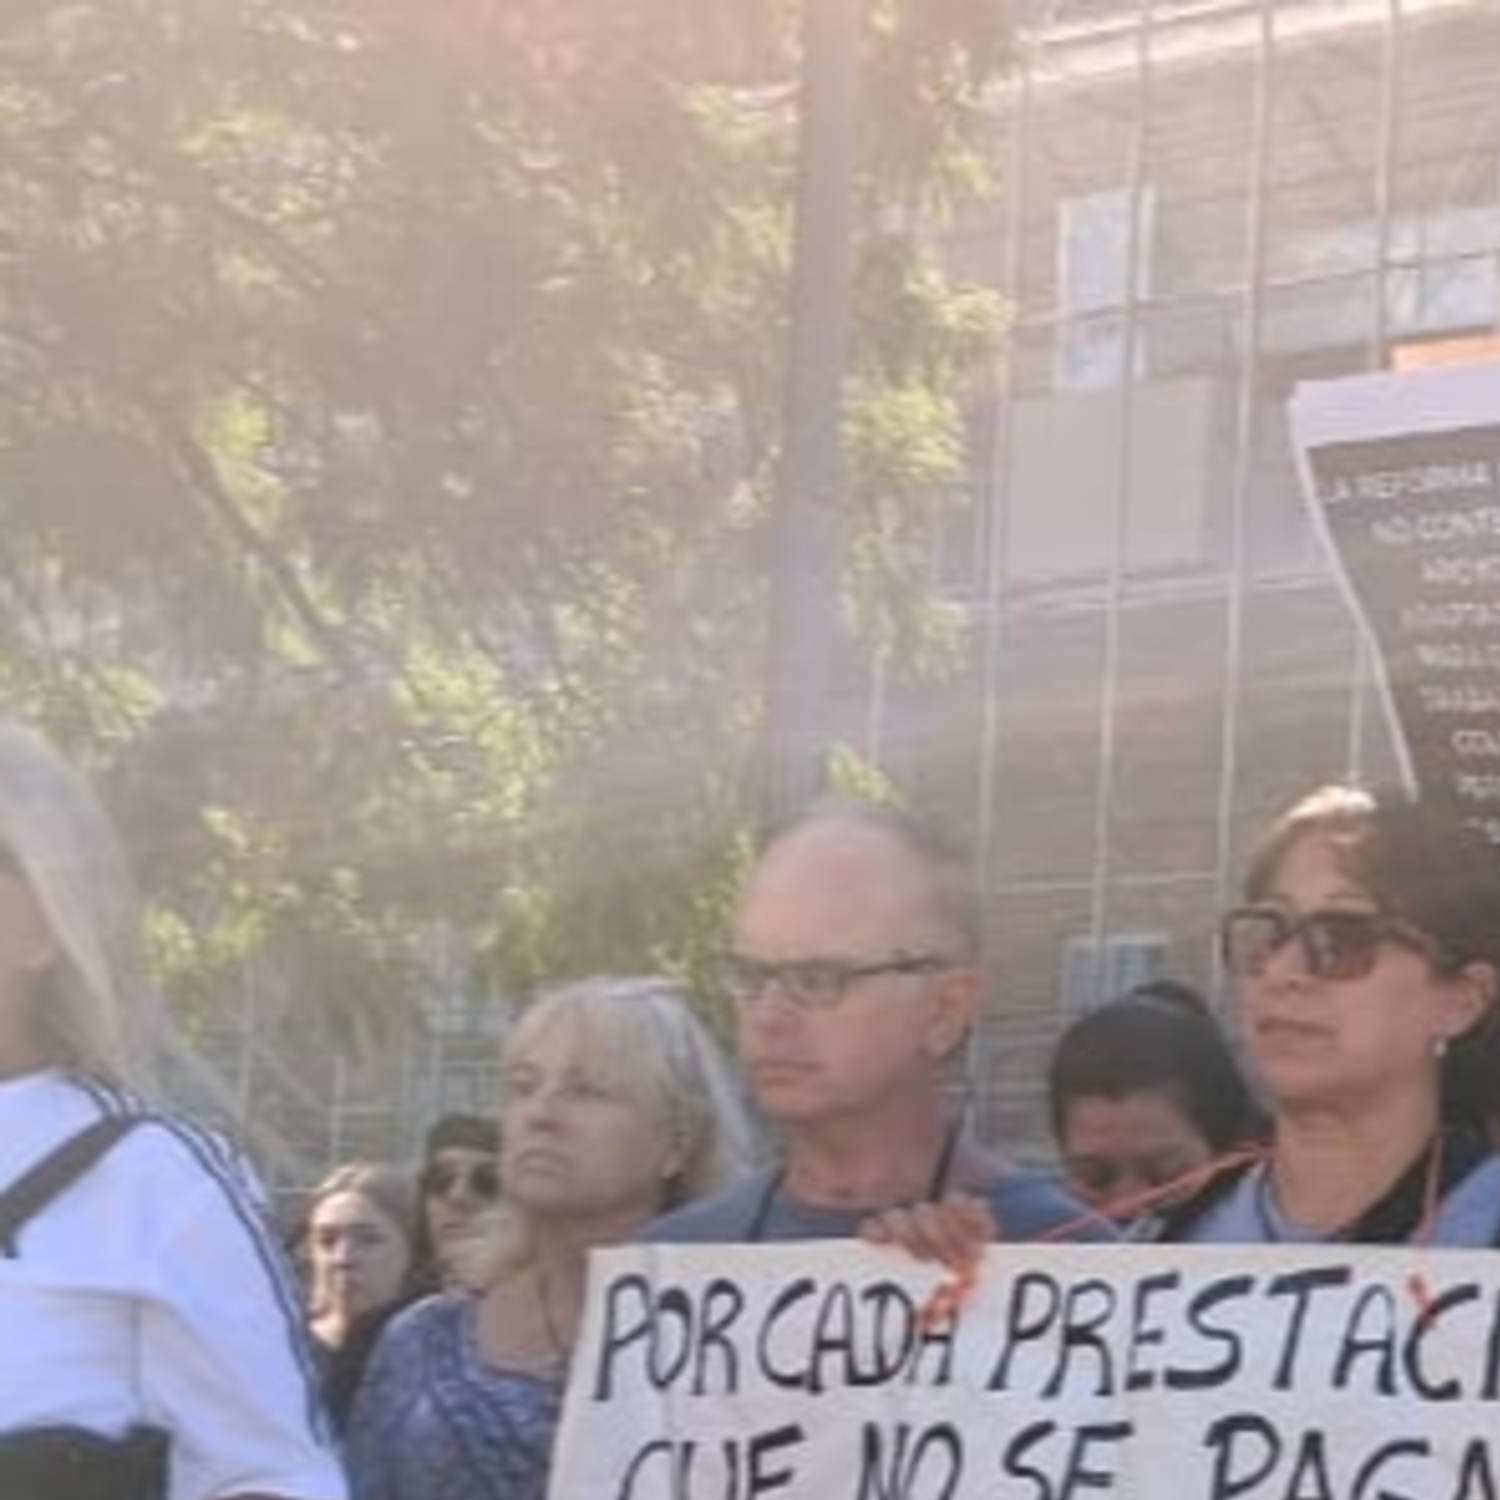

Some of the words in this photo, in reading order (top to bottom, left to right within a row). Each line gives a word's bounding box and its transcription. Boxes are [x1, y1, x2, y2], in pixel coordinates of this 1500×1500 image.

[1357, 462, 1490, 500] REFORMA
[594, 1274, 744, 1401] POR
[757, 1277, 960, 1394] CADA
